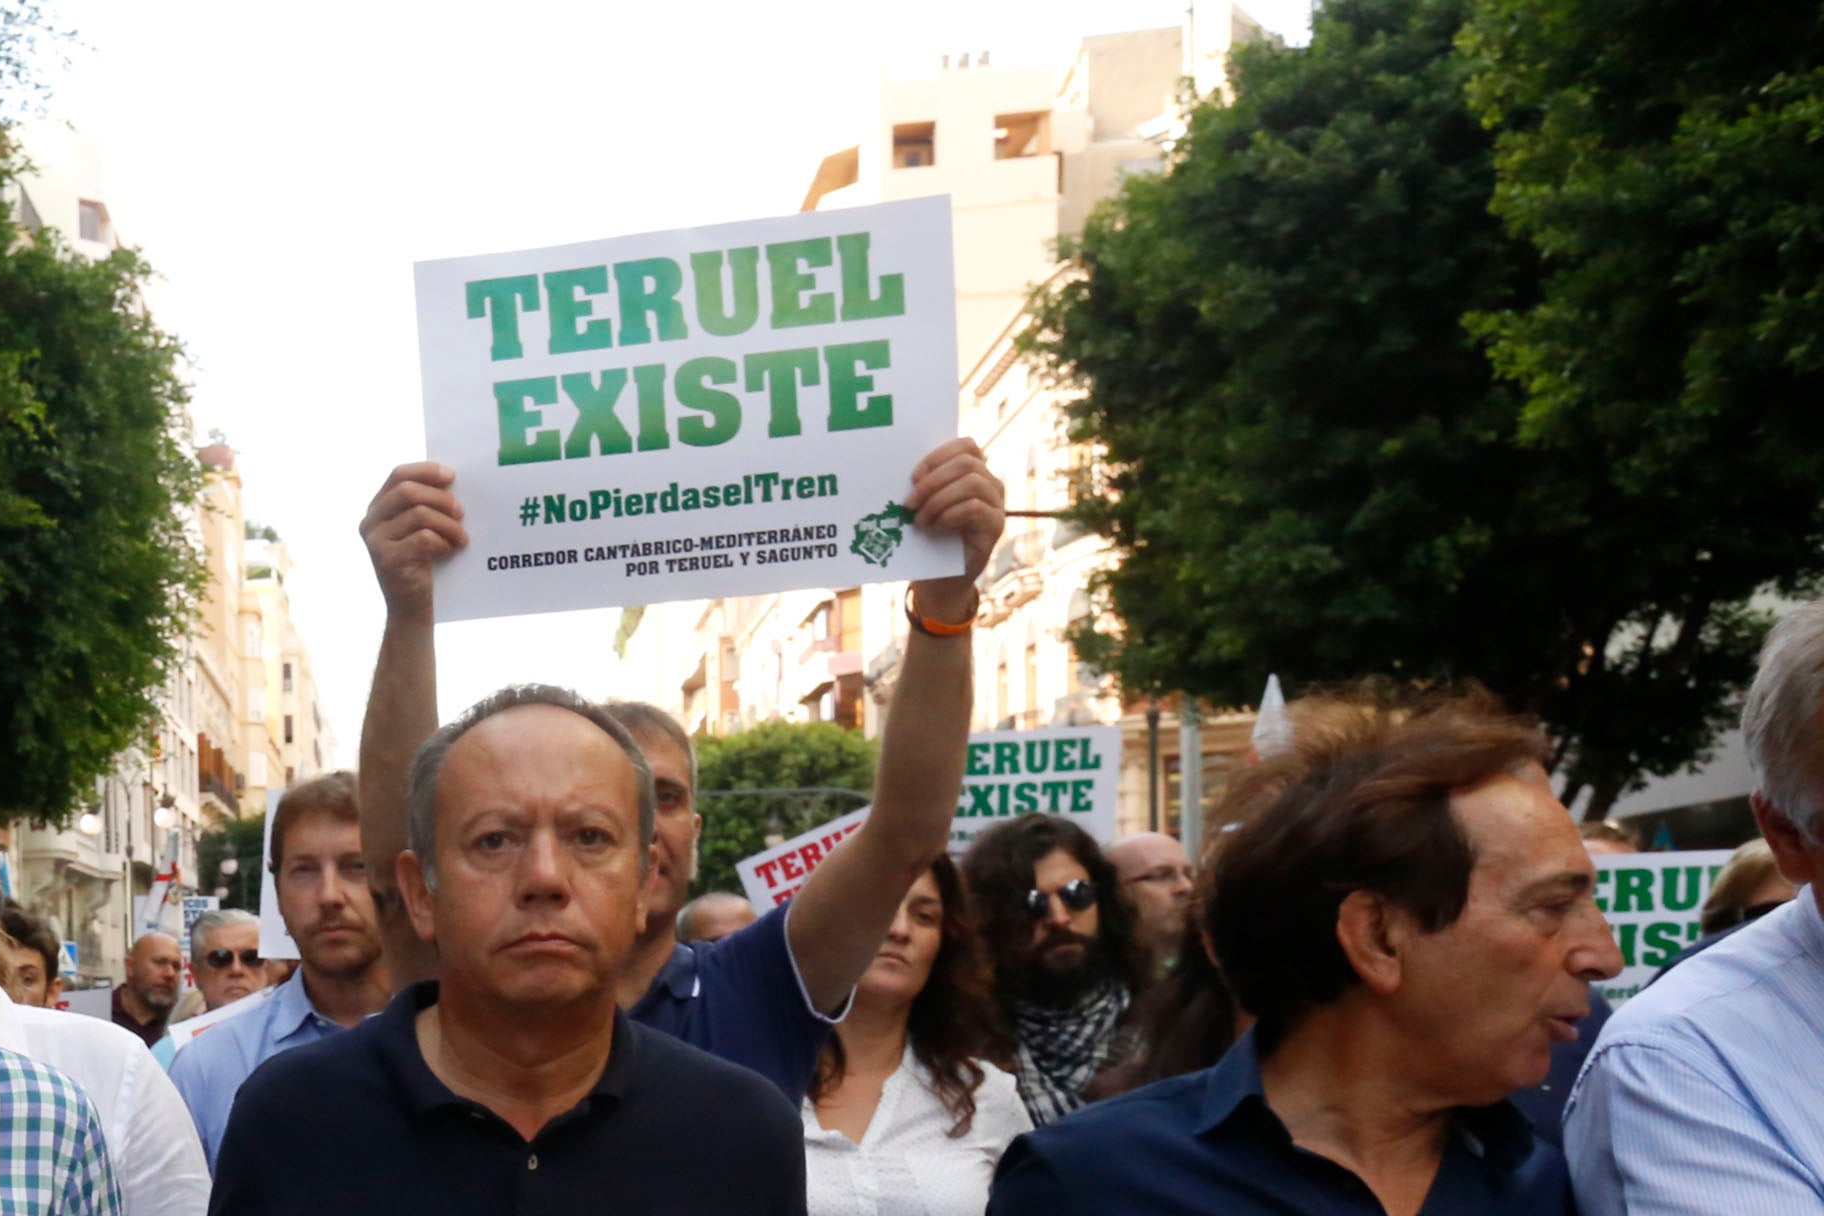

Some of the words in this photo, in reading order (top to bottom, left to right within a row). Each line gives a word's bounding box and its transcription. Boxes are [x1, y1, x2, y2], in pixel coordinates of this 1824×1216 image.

[465, 231, 905, 362] TERUEL
[492, 339, 893, 466] EXISTE
[519, 473, 839, 526] #NoPierdaselTren
[487, 550, 578, 571] CORREDOR
[584, 523, 838, 562] CANTÁBRICO-MEDITERRÁNEO
[625, 560, 660, 577] POR
[665, 549, 733, 574] TERUEL
[740, 551, 751, 566] Y
[756, 543, 838, 565] SAGUNTO
[965, 738, 1102, 776] ERUEL
